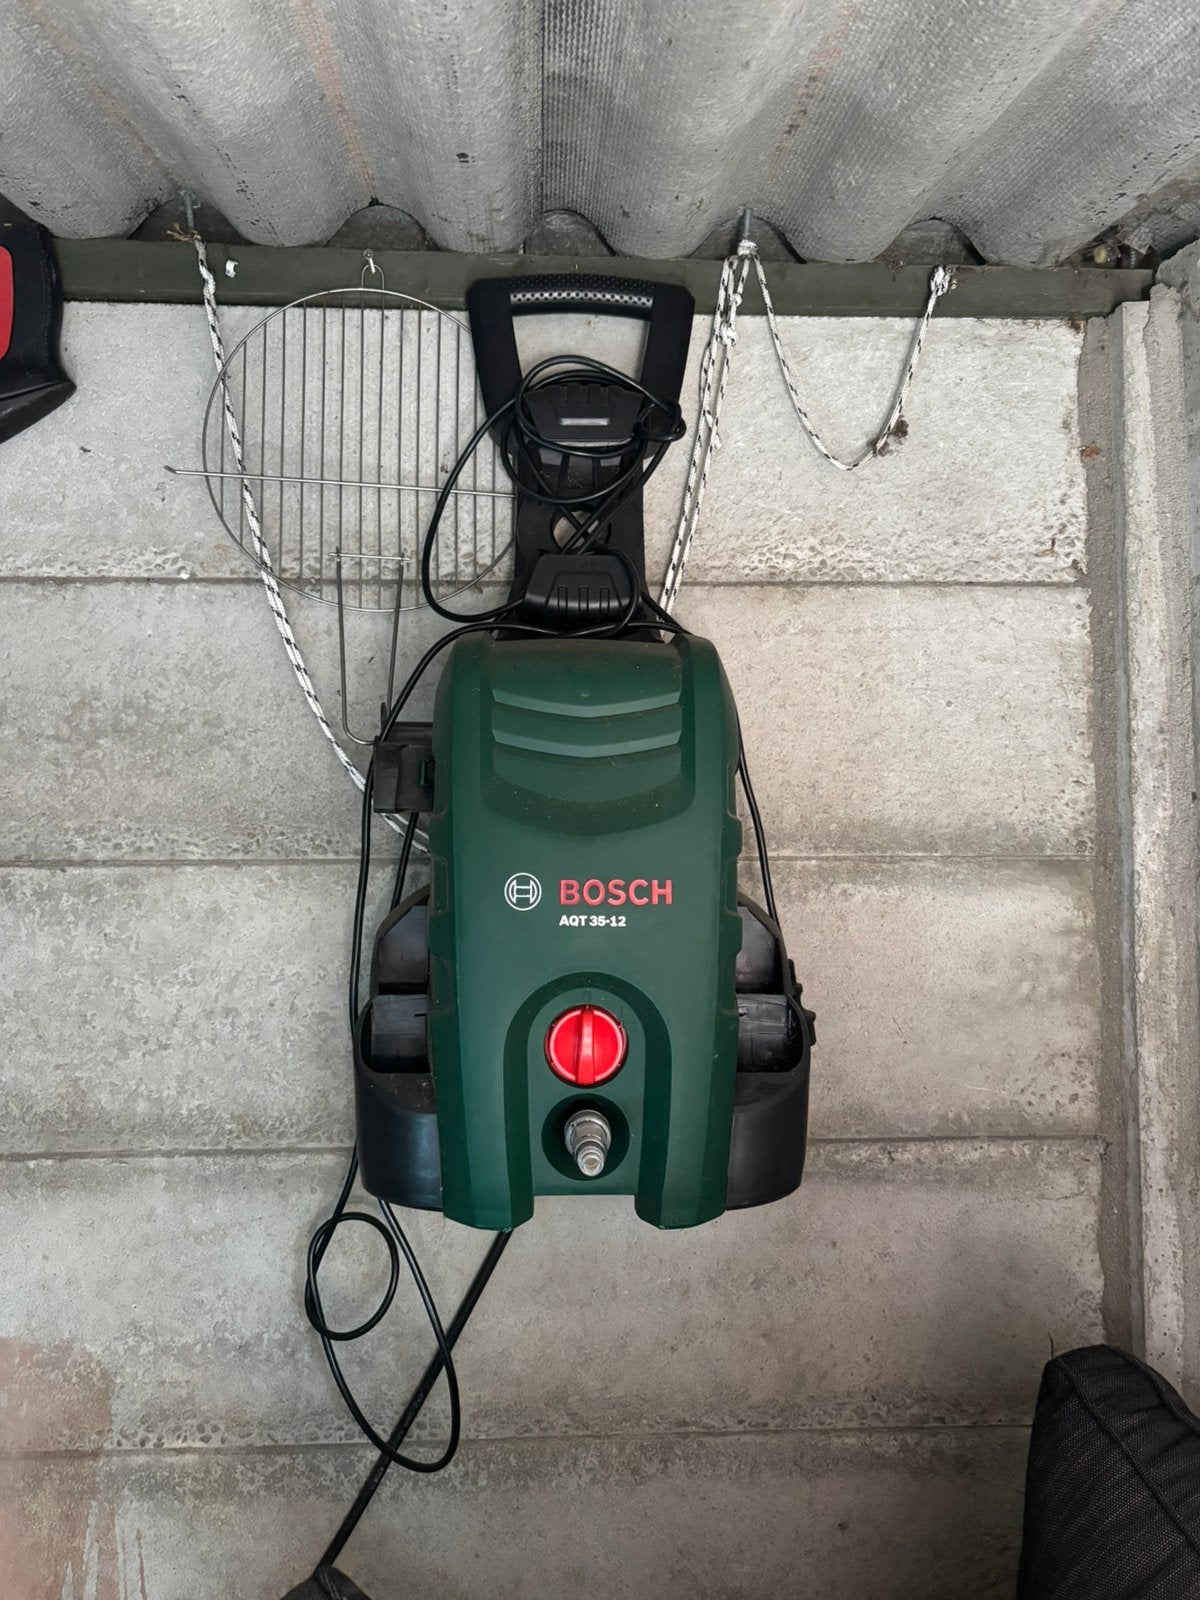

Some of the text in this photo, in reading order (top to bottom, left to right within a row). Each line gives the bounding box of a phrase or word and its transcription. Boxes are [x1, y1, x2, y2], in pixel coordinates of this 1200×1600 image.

[559, 879, 673, 906] BOSCH
[558, 914, 627, 928] AQT 35-12
